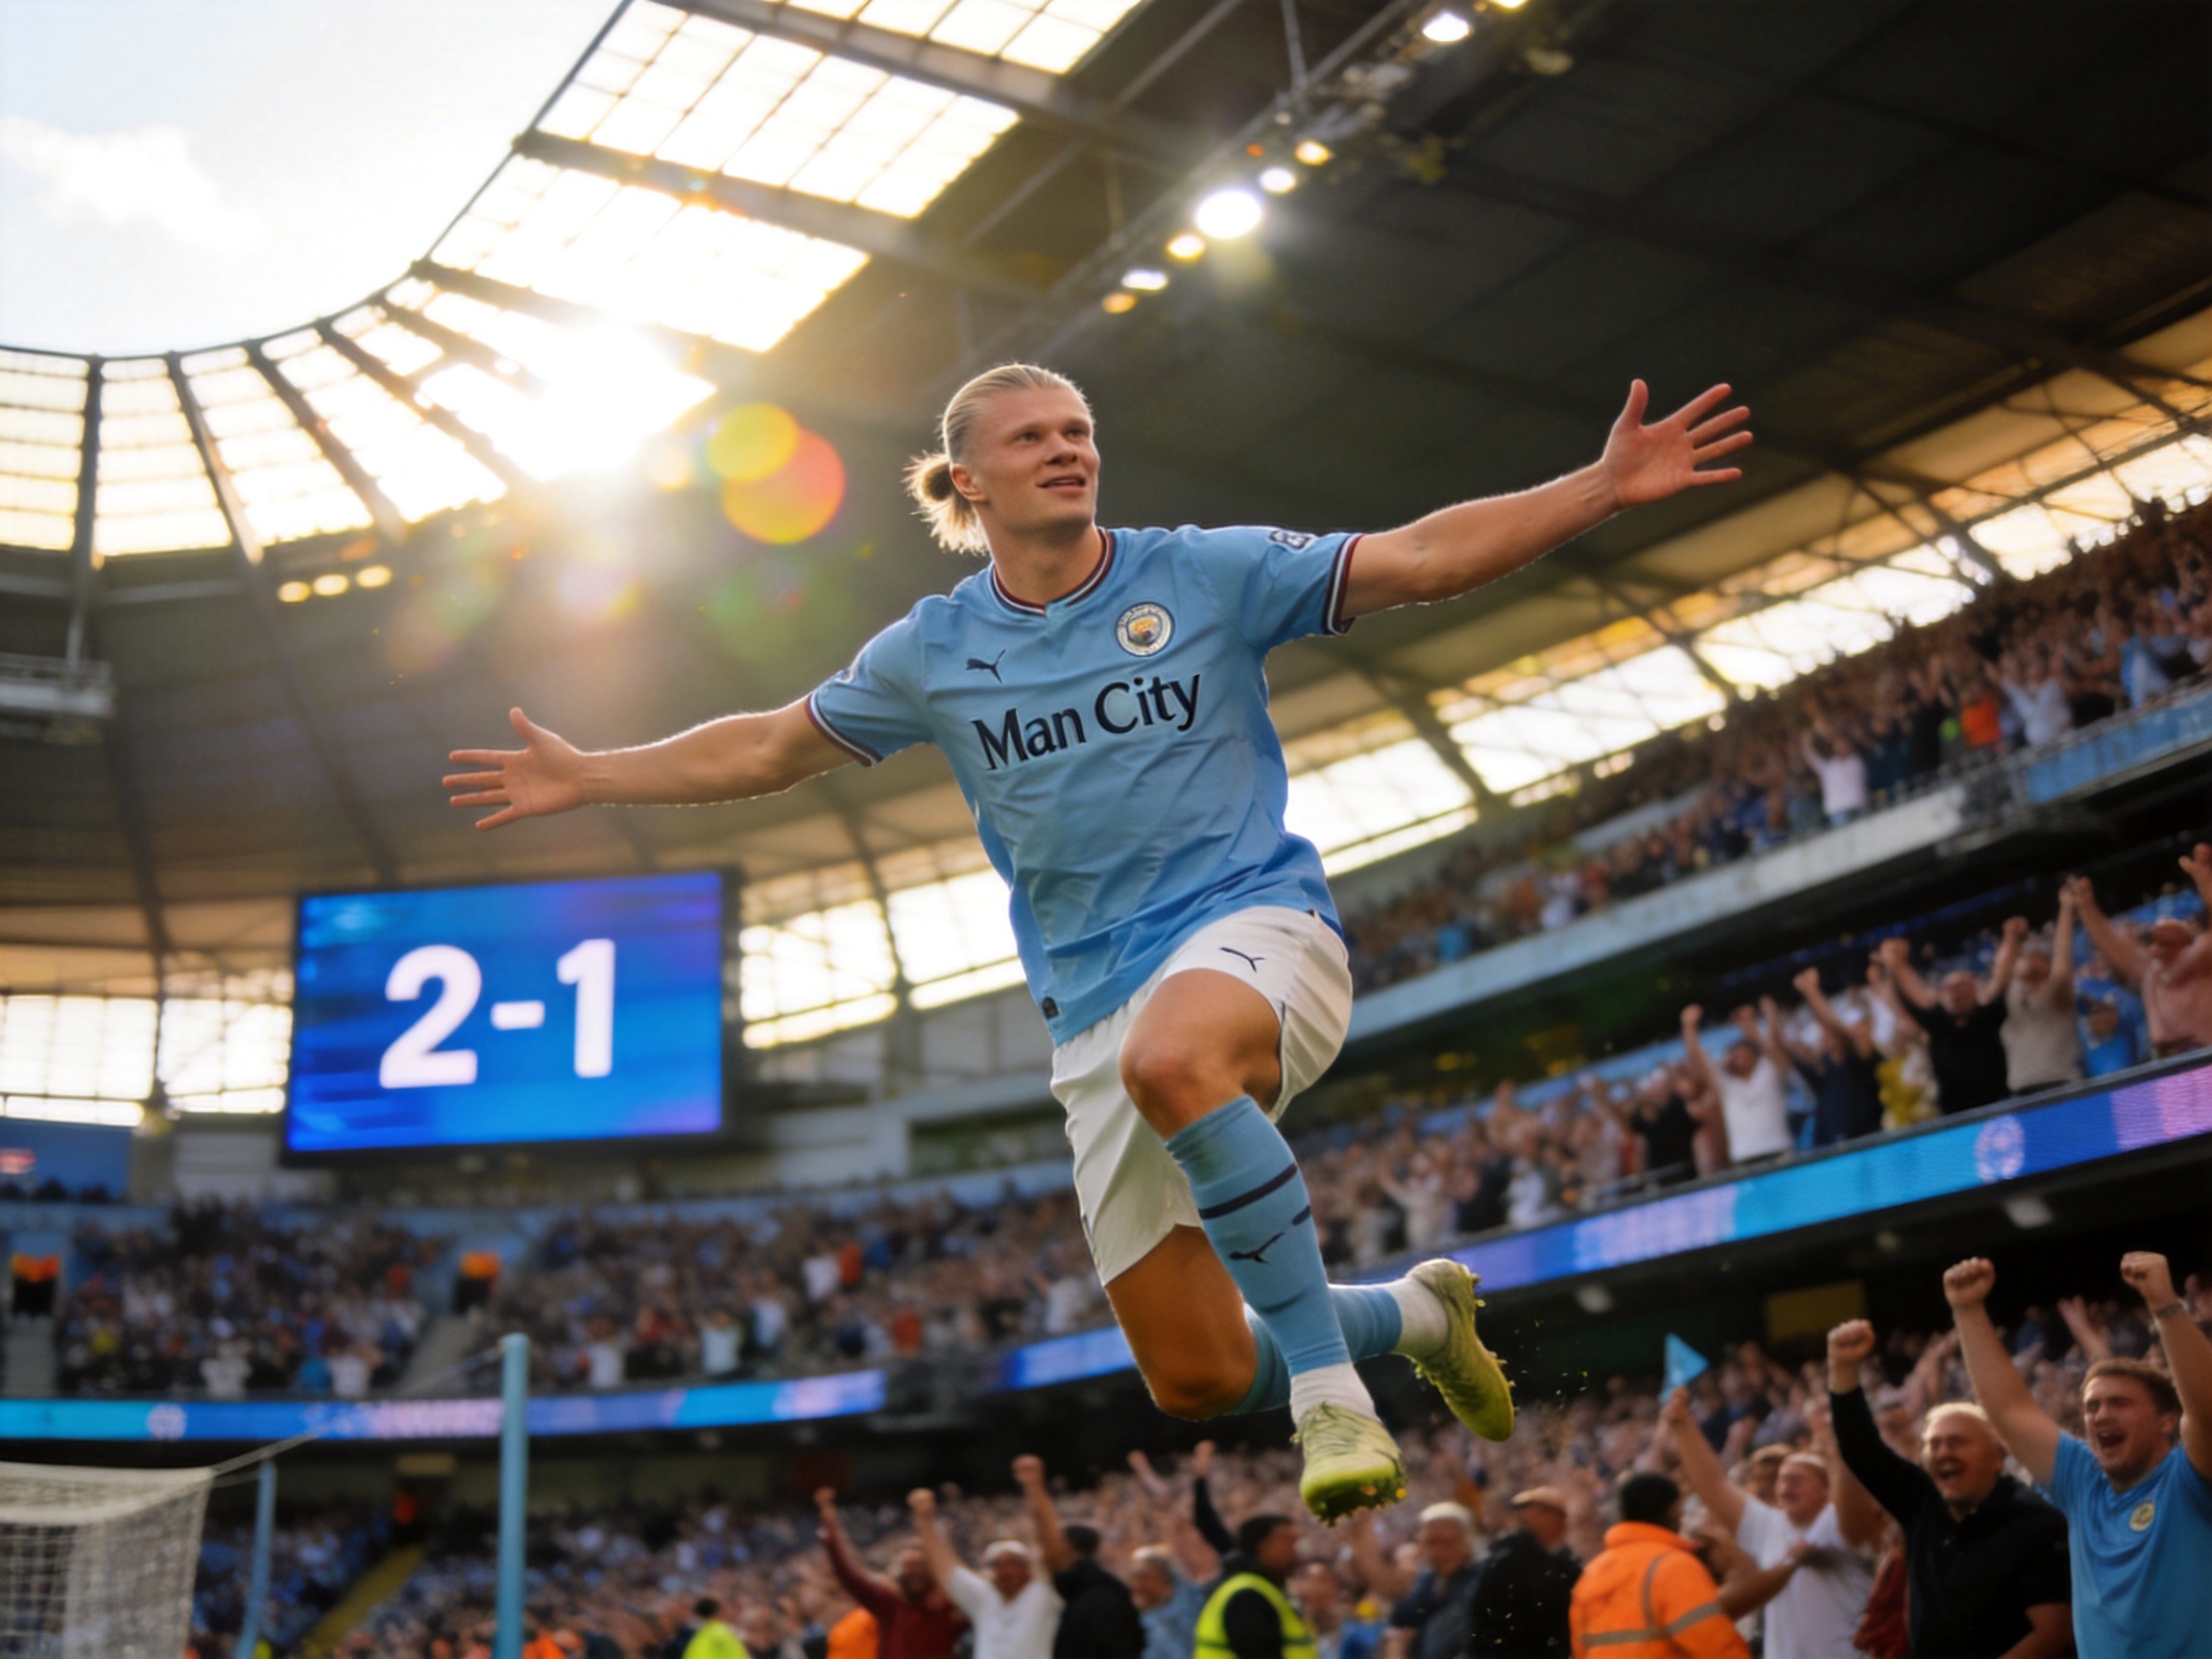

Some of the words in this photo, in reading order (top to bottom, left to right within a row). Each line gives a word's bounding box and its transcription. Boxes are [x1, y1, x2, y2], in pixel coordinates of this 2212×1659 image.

[972, 708, 1087, 770] Man
[1094, 674, 1200, 734] City
[379, 938, 615, 1089] 2-1
